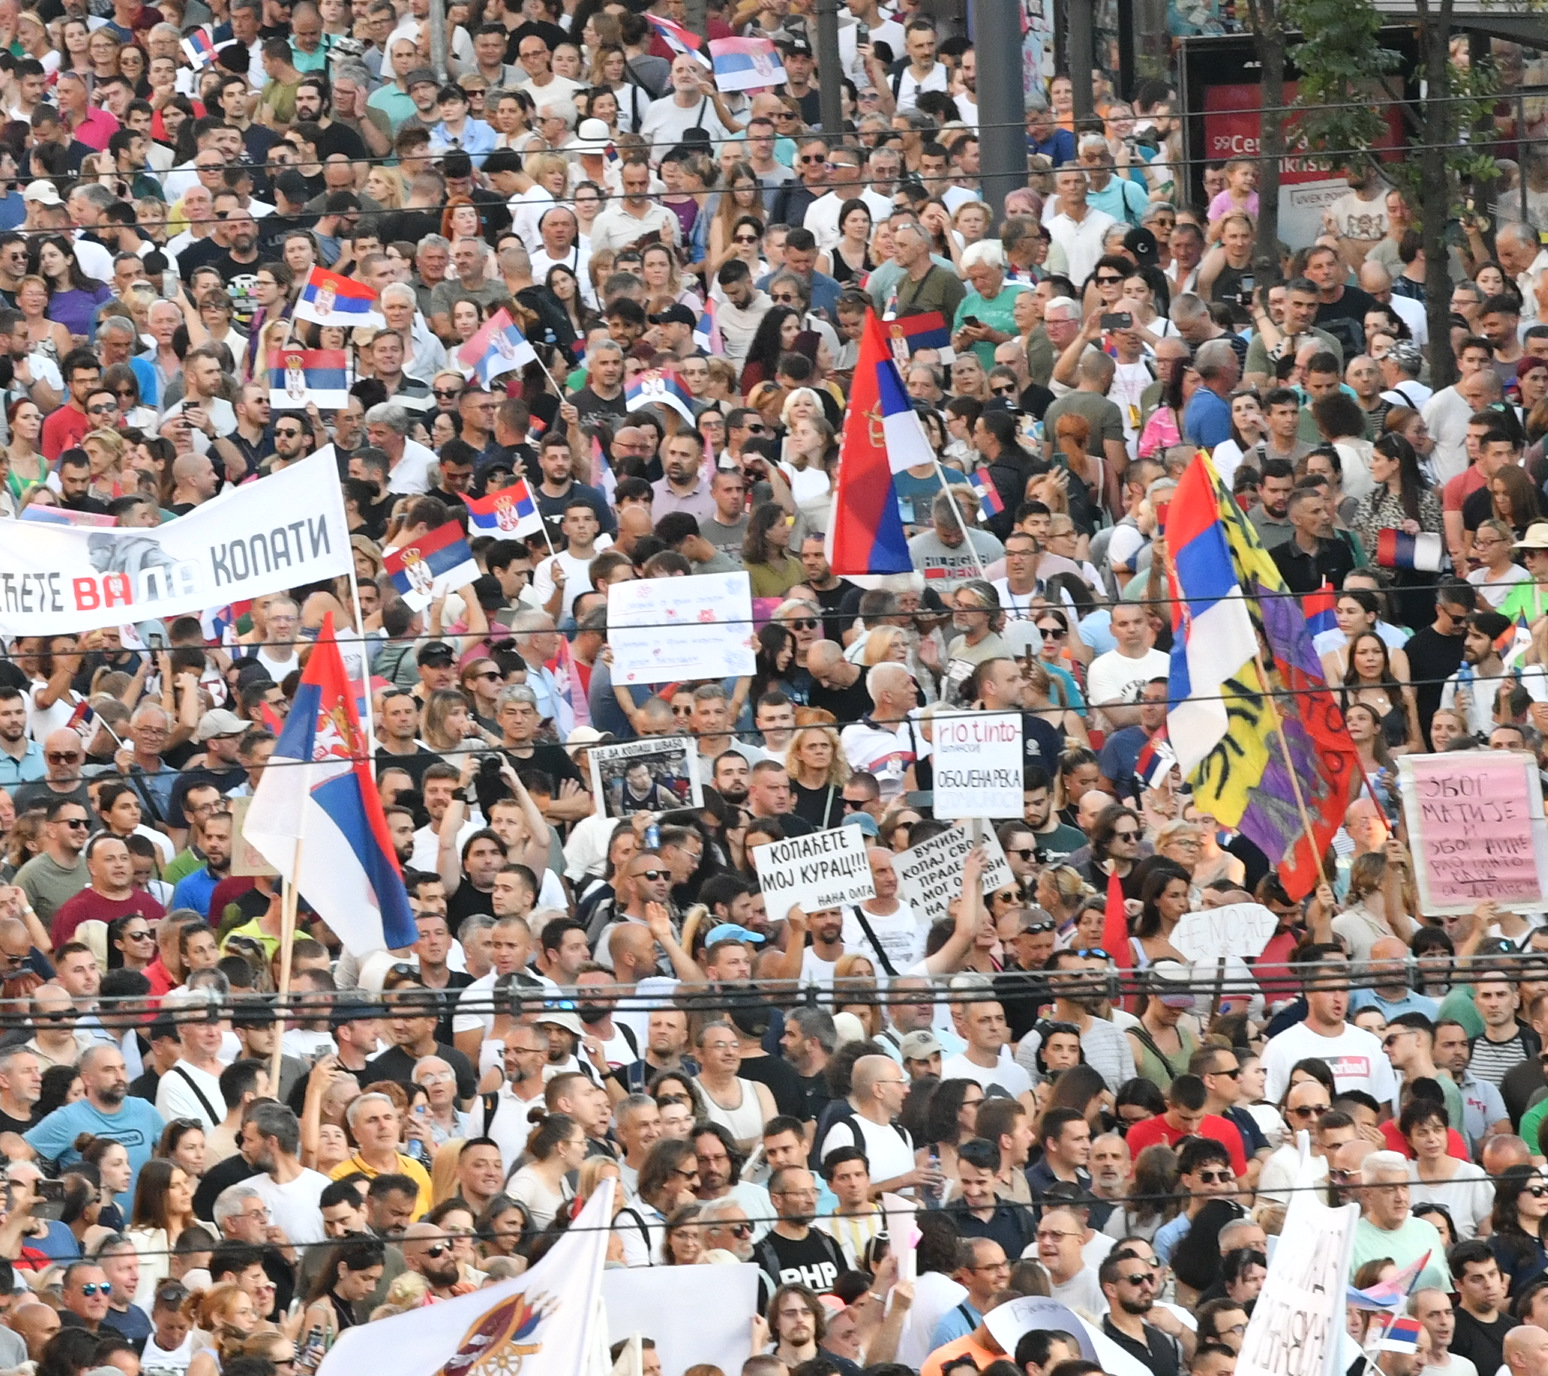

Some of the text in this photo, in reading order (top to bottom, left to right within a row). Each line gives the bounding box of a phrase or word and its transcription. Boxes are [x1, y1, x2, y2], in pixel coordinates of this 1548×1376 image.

[210, 512, 332, 587] КОПАТИ
[769, 830, 849, 866] КОПАЋЕТЕ
[913, 826, 966, 859] ВУЧИЋУ
[761, 851, 868, 893] МОЈ КУРАЦ!!!
[900, 856, 946, 882] КОПАЈ
[816, 884, 875, 907] НАНА ОЛГА
